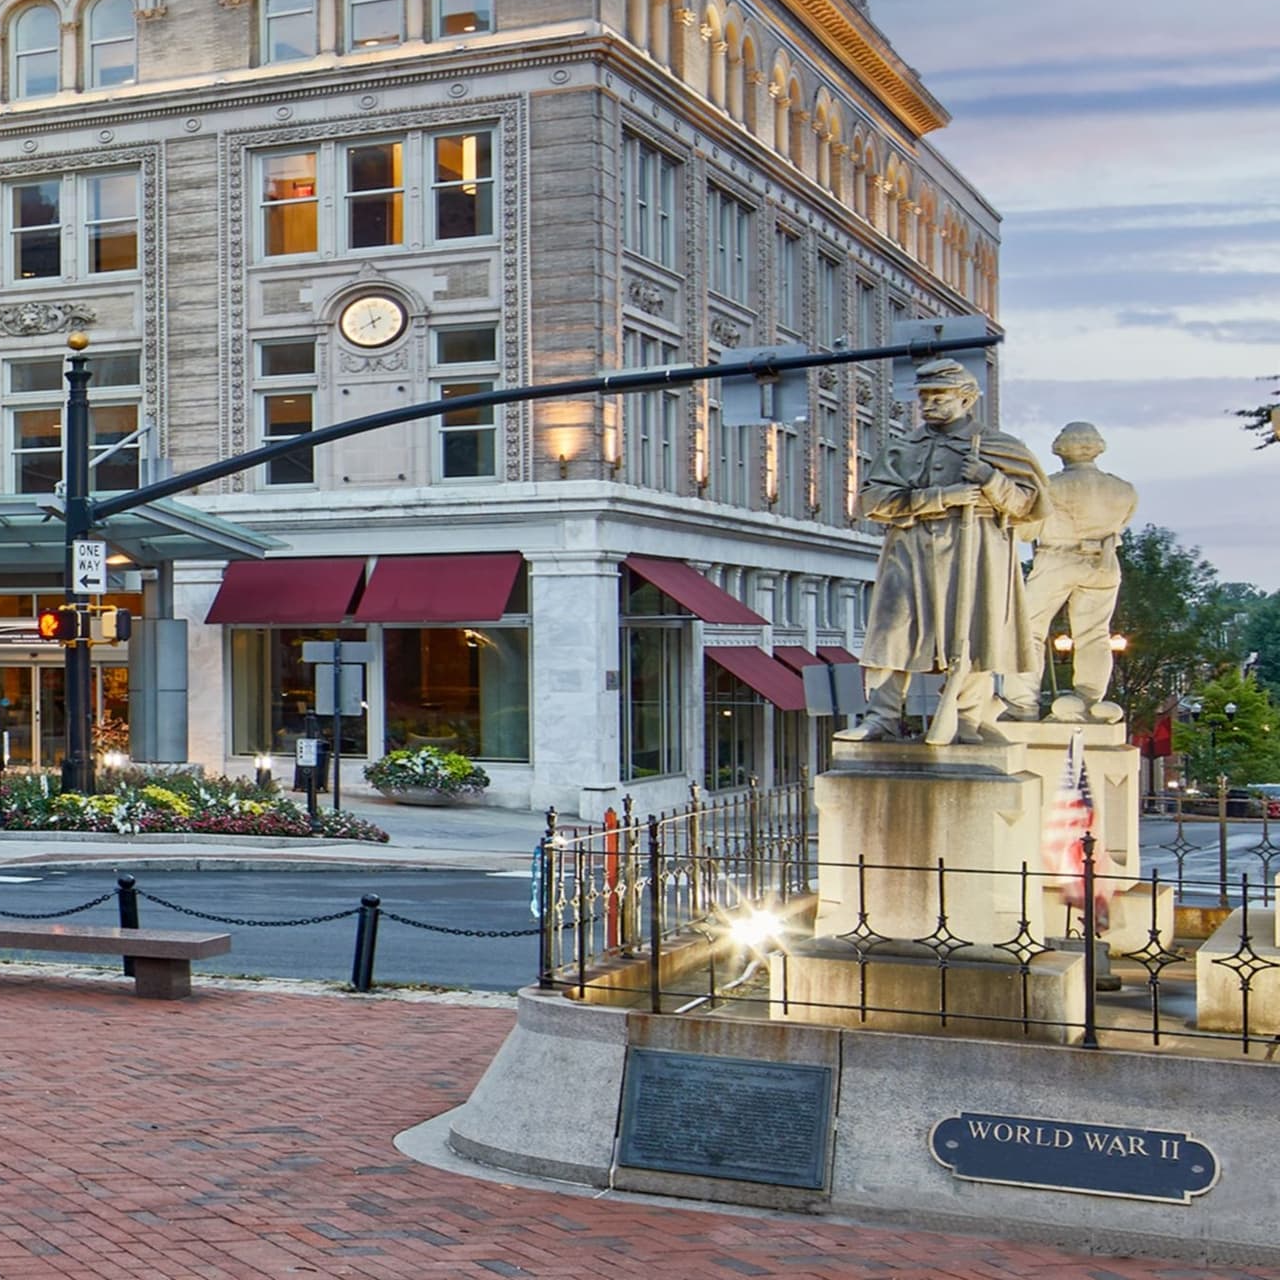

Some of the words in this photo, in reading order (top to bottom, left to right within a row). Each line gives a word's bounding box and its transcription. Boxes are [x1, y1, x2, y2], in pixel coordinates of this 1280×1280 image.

[79, 544, 100, 557] ONE
[79, 560, 101, 571] WAY
[968, 1120, 1074, 1148] WORLD
[1083, 1131, 1150, 1157] WAR
[1160, 1139, 1181, 1160] II
